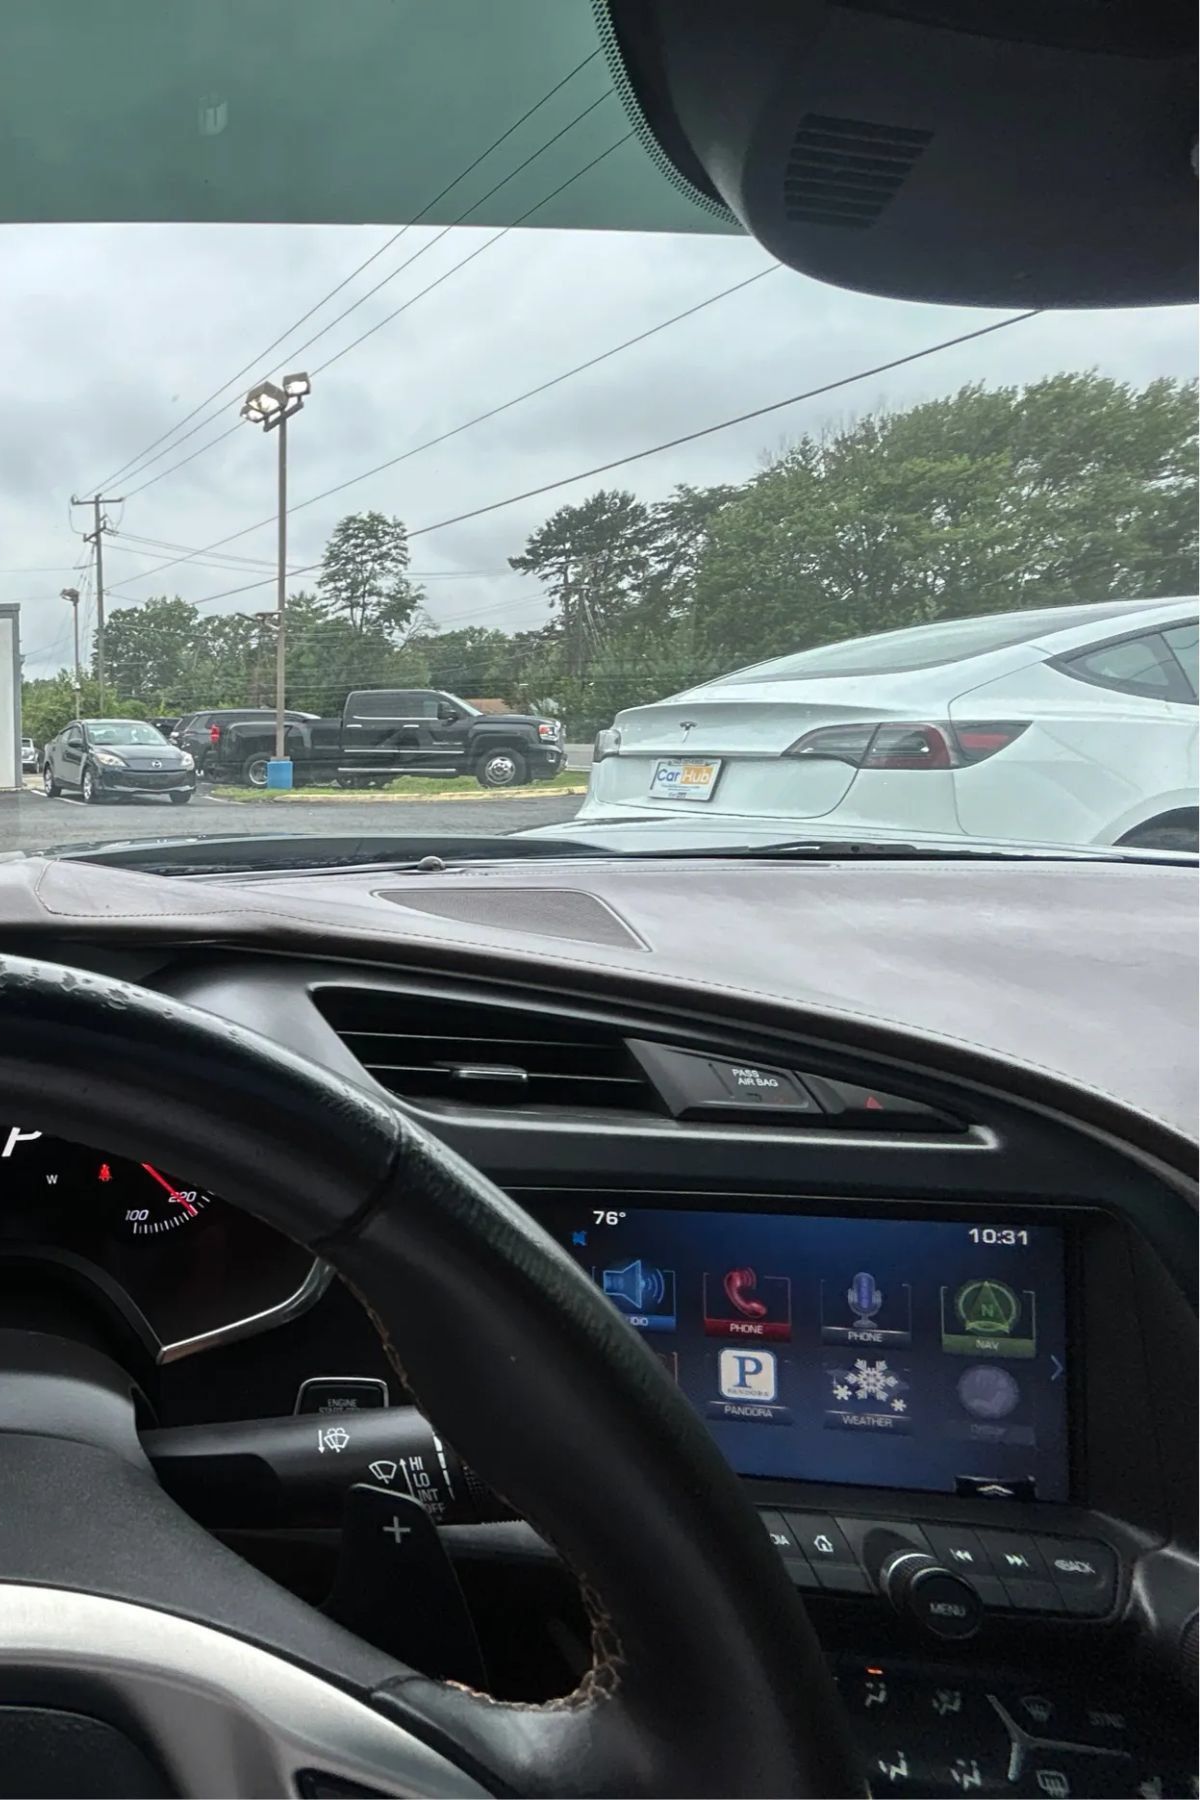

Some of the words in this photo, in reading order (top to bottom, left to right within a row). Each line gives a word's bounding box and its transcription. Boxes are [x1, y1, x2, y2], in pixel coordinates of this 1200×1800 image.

[657, 769, 680, 781] Car
[682, 767, 710, 782] Hub
[731, 1068, 760, 1078] PASS
[738, 1078, 756, 1086] AIR
[756, 1079, 779, 1088] BAG
[46, 1174, 58, 1185] W
[125, 1209, 149, 1221] 100
[593, 1210, 627, 1226] 76°
[968, 1227, 1029, 1246] 10:31
[729, 1322, 764, 1334] PHONE
[847, 1330, 883, 1343] PHONE
[975, 1338, 1000, 1351] NAV
[732, 1355, 763, 1389] P
[327, 1399, 358, 1407] ENGINE
[724, 1404, 773, 1419] PANDORA
[842, 1414, 894, 1428] WEATHER
[408, 1456, 424, 1471] HI
[413, 1472, 430, 1488] LO
[417, 1488, 439, 1501] INT
[930, 1602, 967, 1618] MENU
